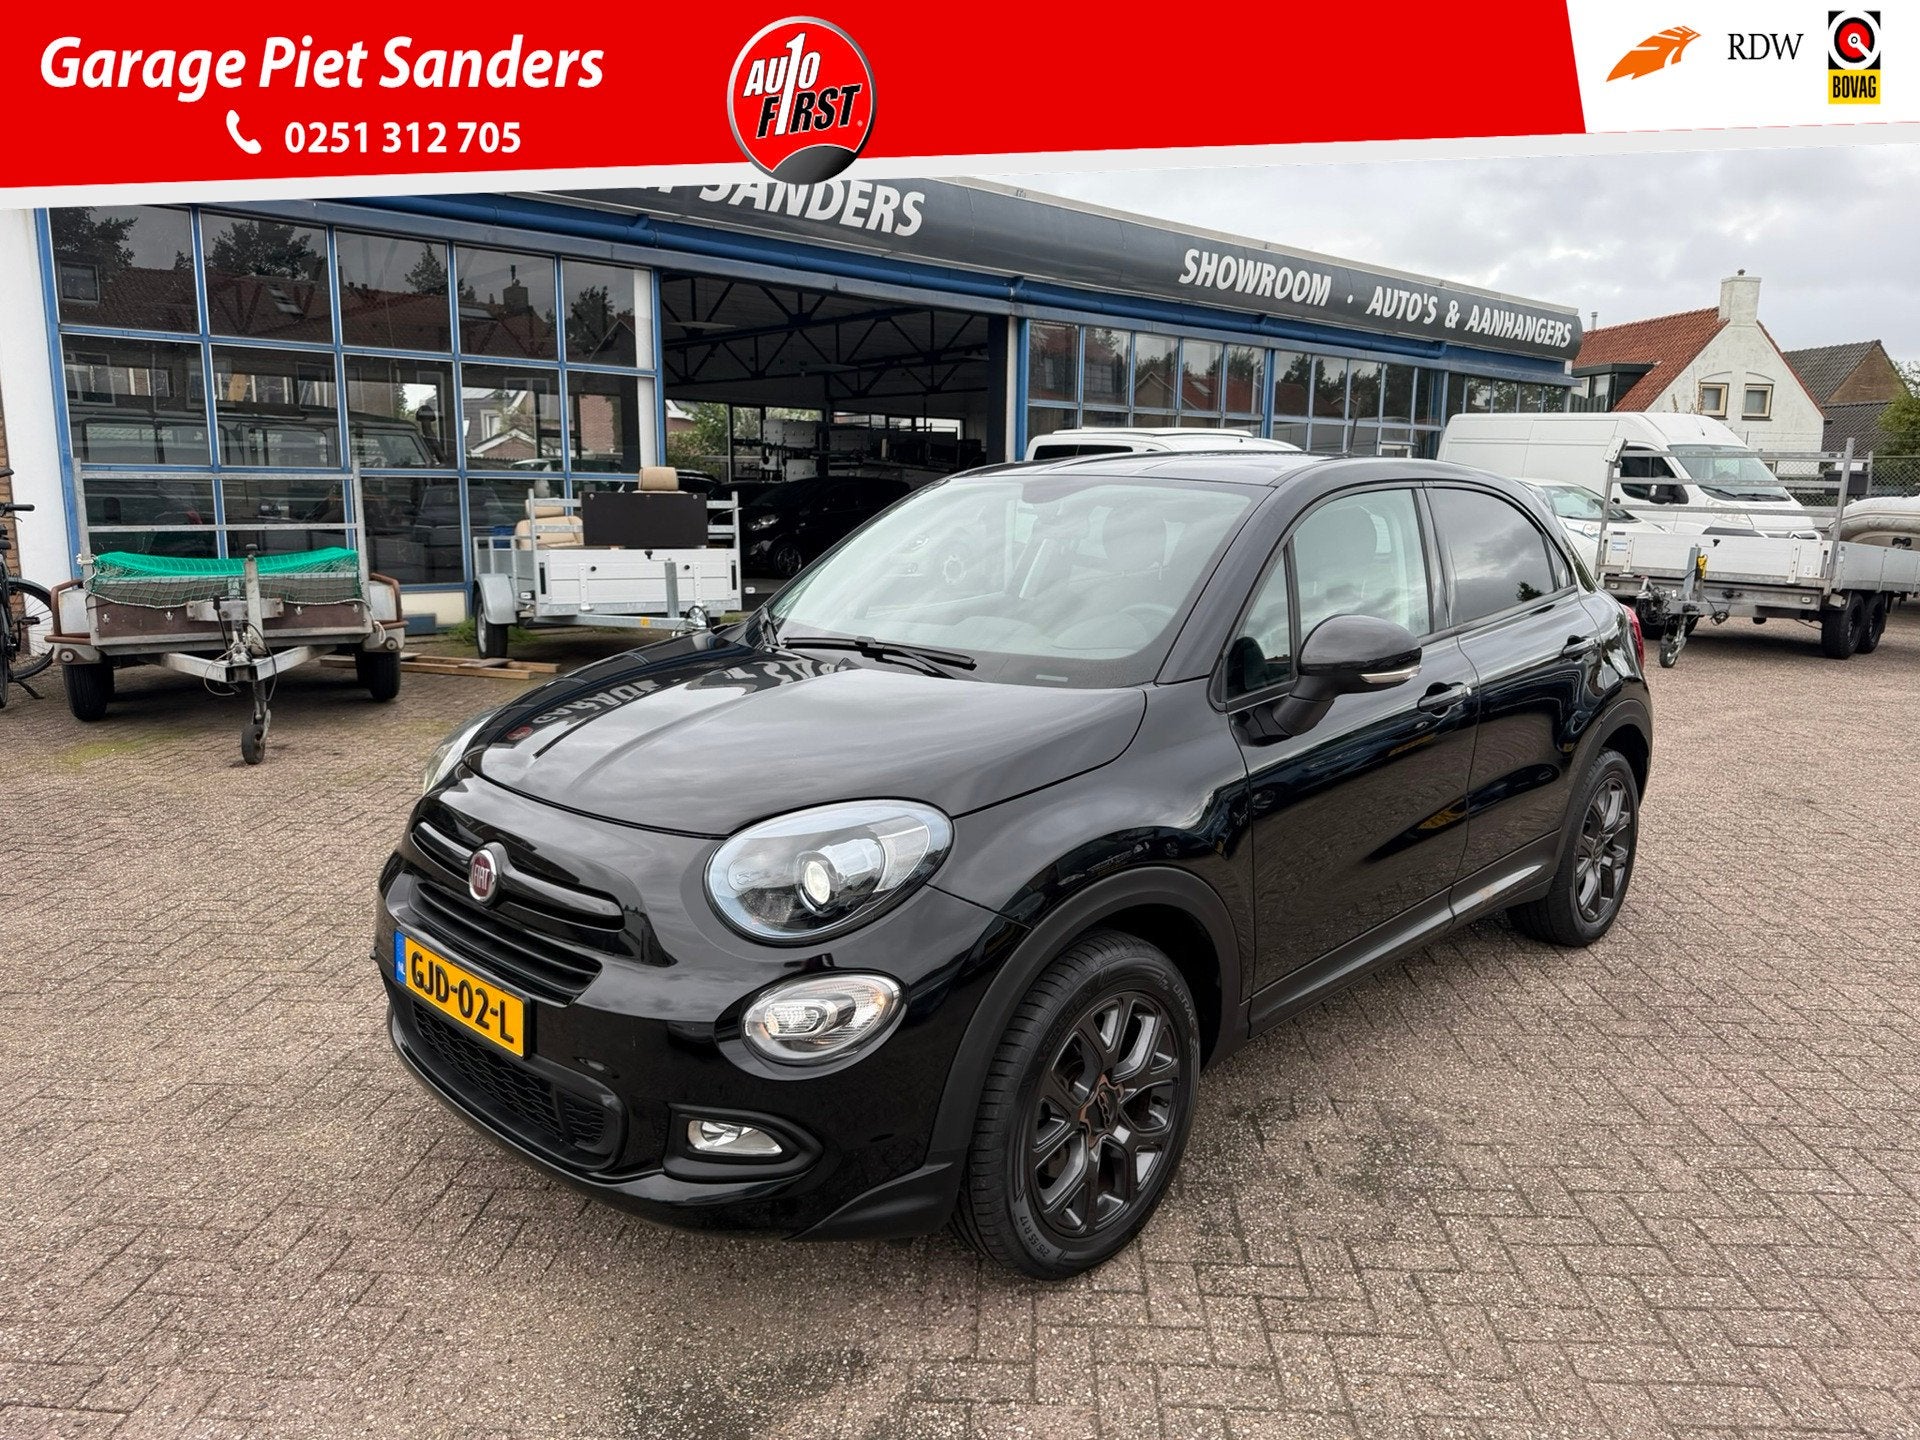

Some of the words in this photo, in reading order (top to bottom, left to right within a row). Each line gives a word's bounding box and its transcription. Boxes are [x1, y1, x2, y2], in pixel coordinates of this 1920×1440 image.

[1178, 248, 1332, 307] SHOWROOM
[1365, 285, 1438, 326] AUTO'S
[1443, 299, 1461, 329] &
[1465, 304, 1573, 349] AANHANGERS
[474, 864, 491, 891] FIAT
[410, 950, 515, 1044] GJD-02-L
